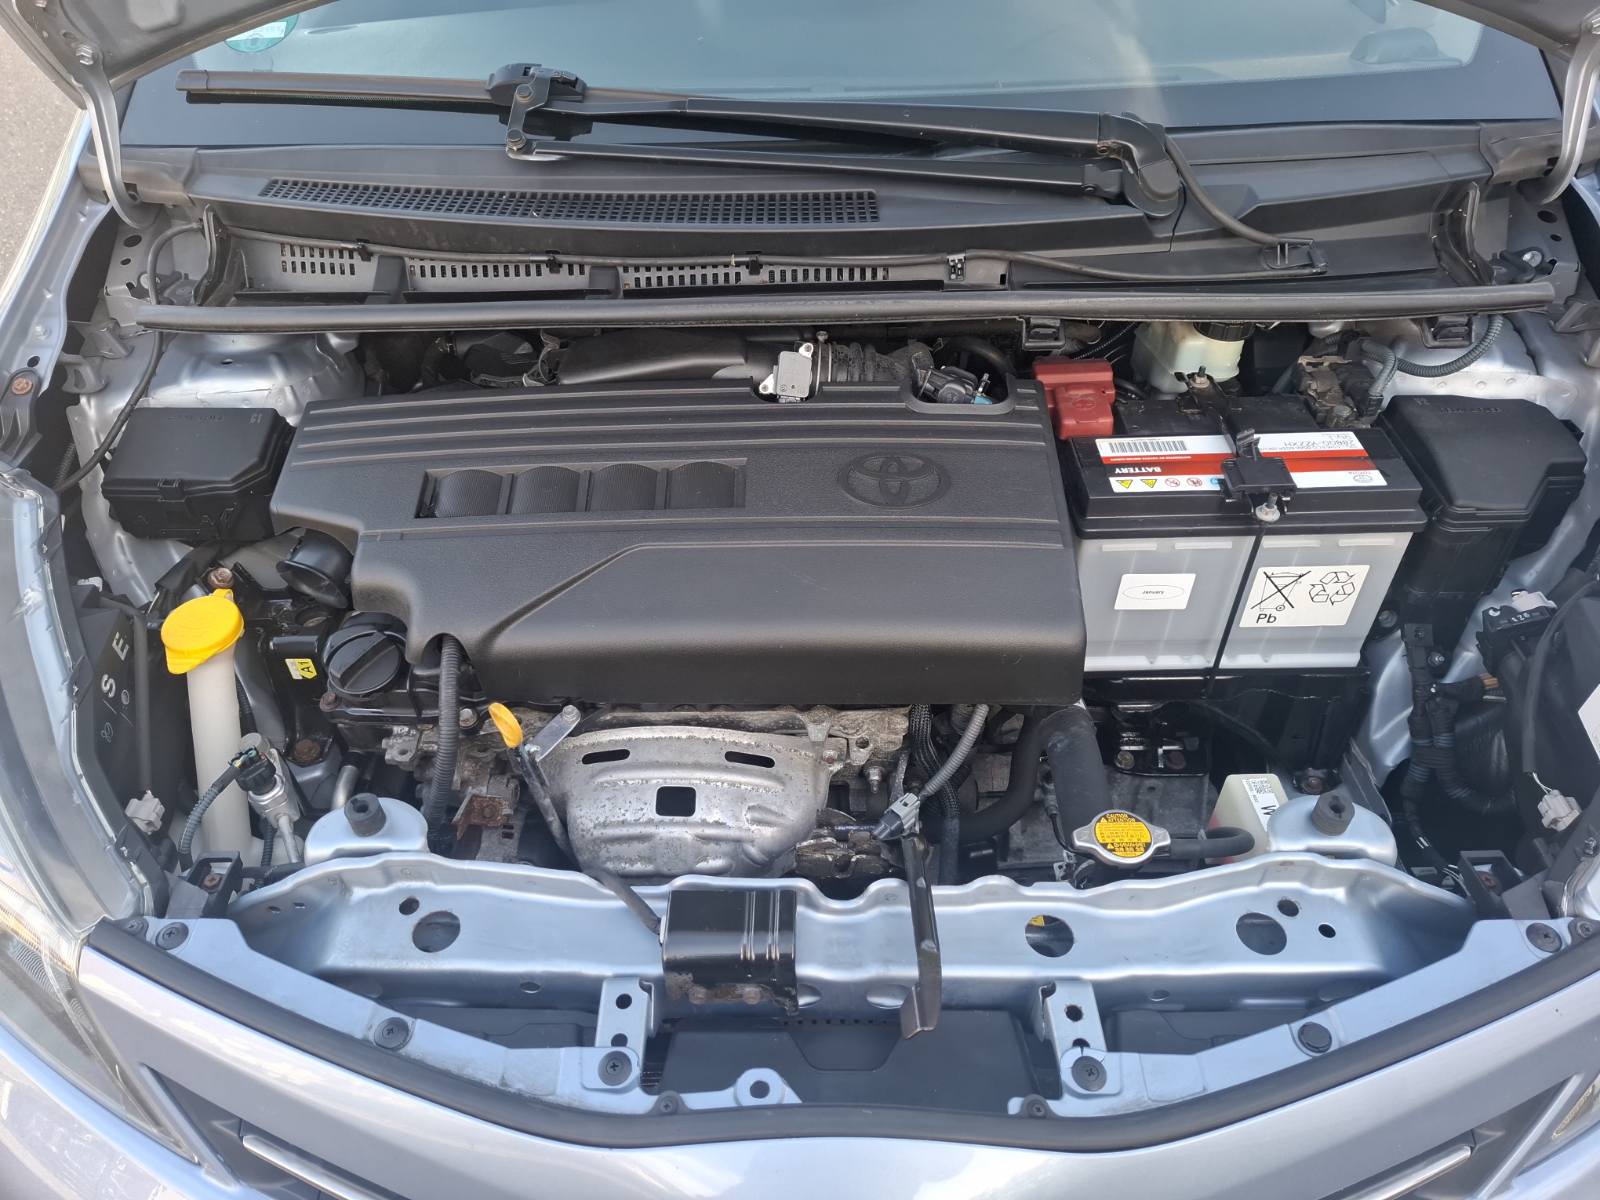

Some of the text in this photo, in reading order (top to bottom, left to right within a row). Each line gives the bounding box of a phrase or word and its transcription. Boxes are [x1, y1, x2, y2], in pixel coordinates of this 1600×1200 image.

[1115, 466, 1162, 475] BATTERY
[1255, 612, 1277, 624] Pb
[101, 674, 115, 698] S
